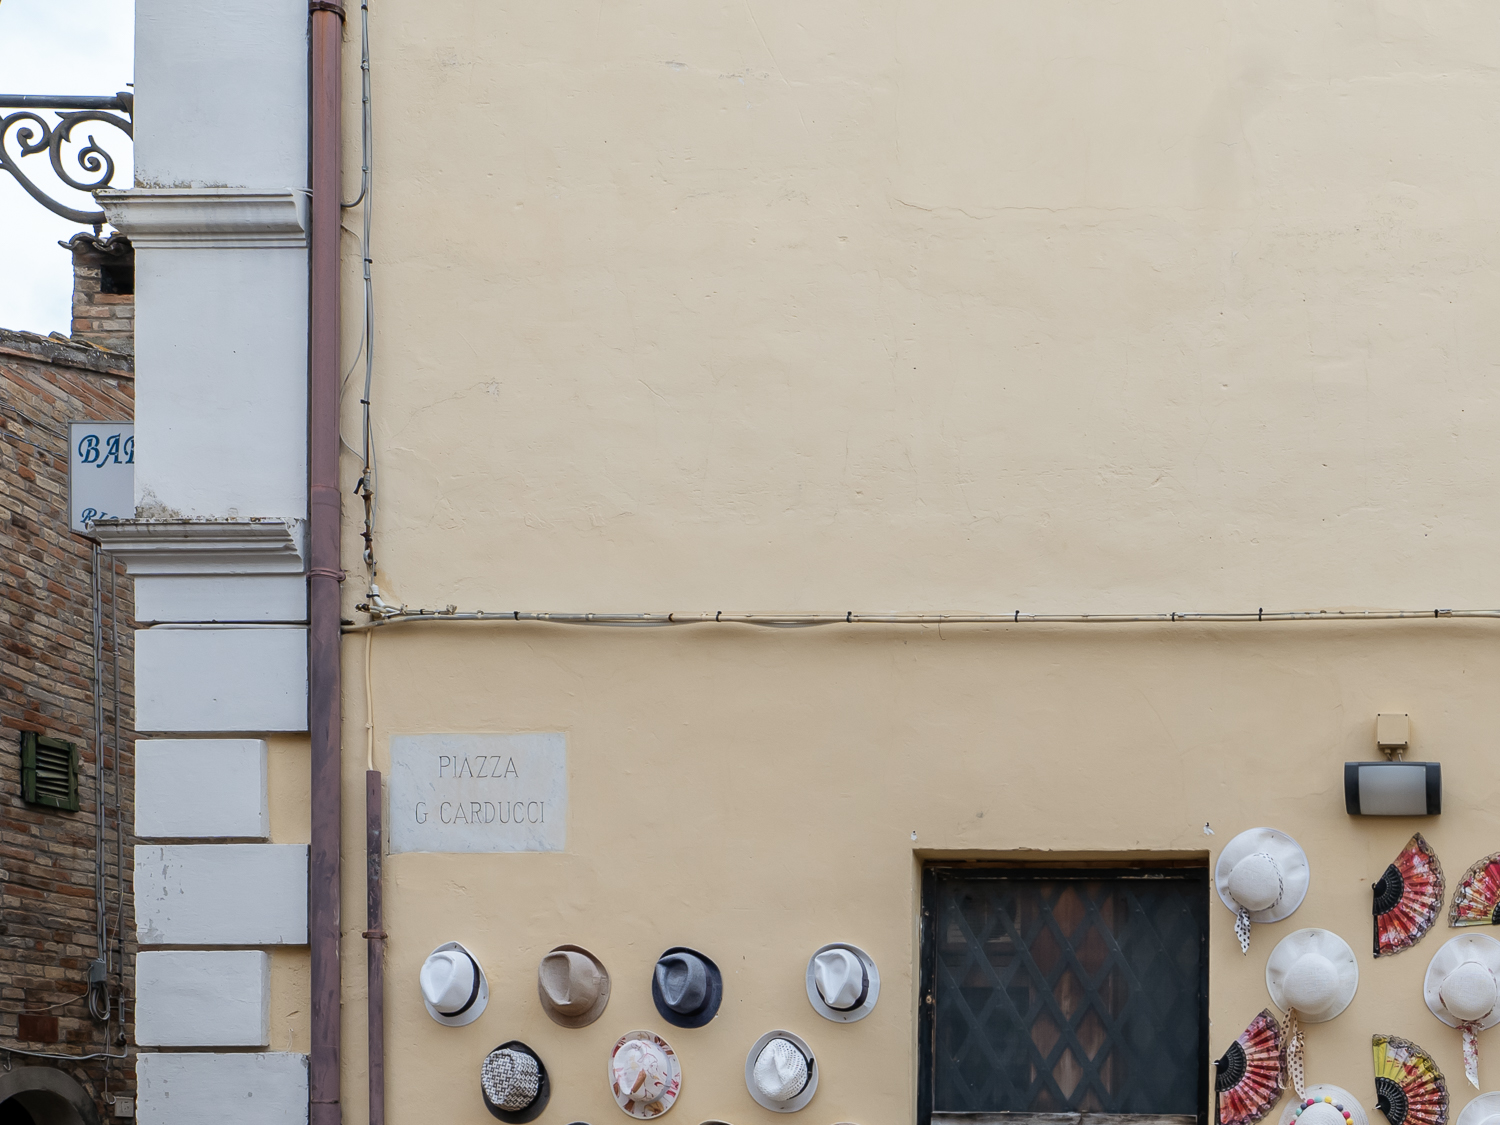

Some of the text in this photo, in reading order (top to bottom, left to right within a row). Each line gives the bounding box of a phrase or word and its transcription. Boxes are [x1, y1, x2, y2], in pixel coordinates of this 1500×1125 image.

[439, 755, 519, 778] PIAZZA
[415, 801, 545, 824] G CARDUCCI
